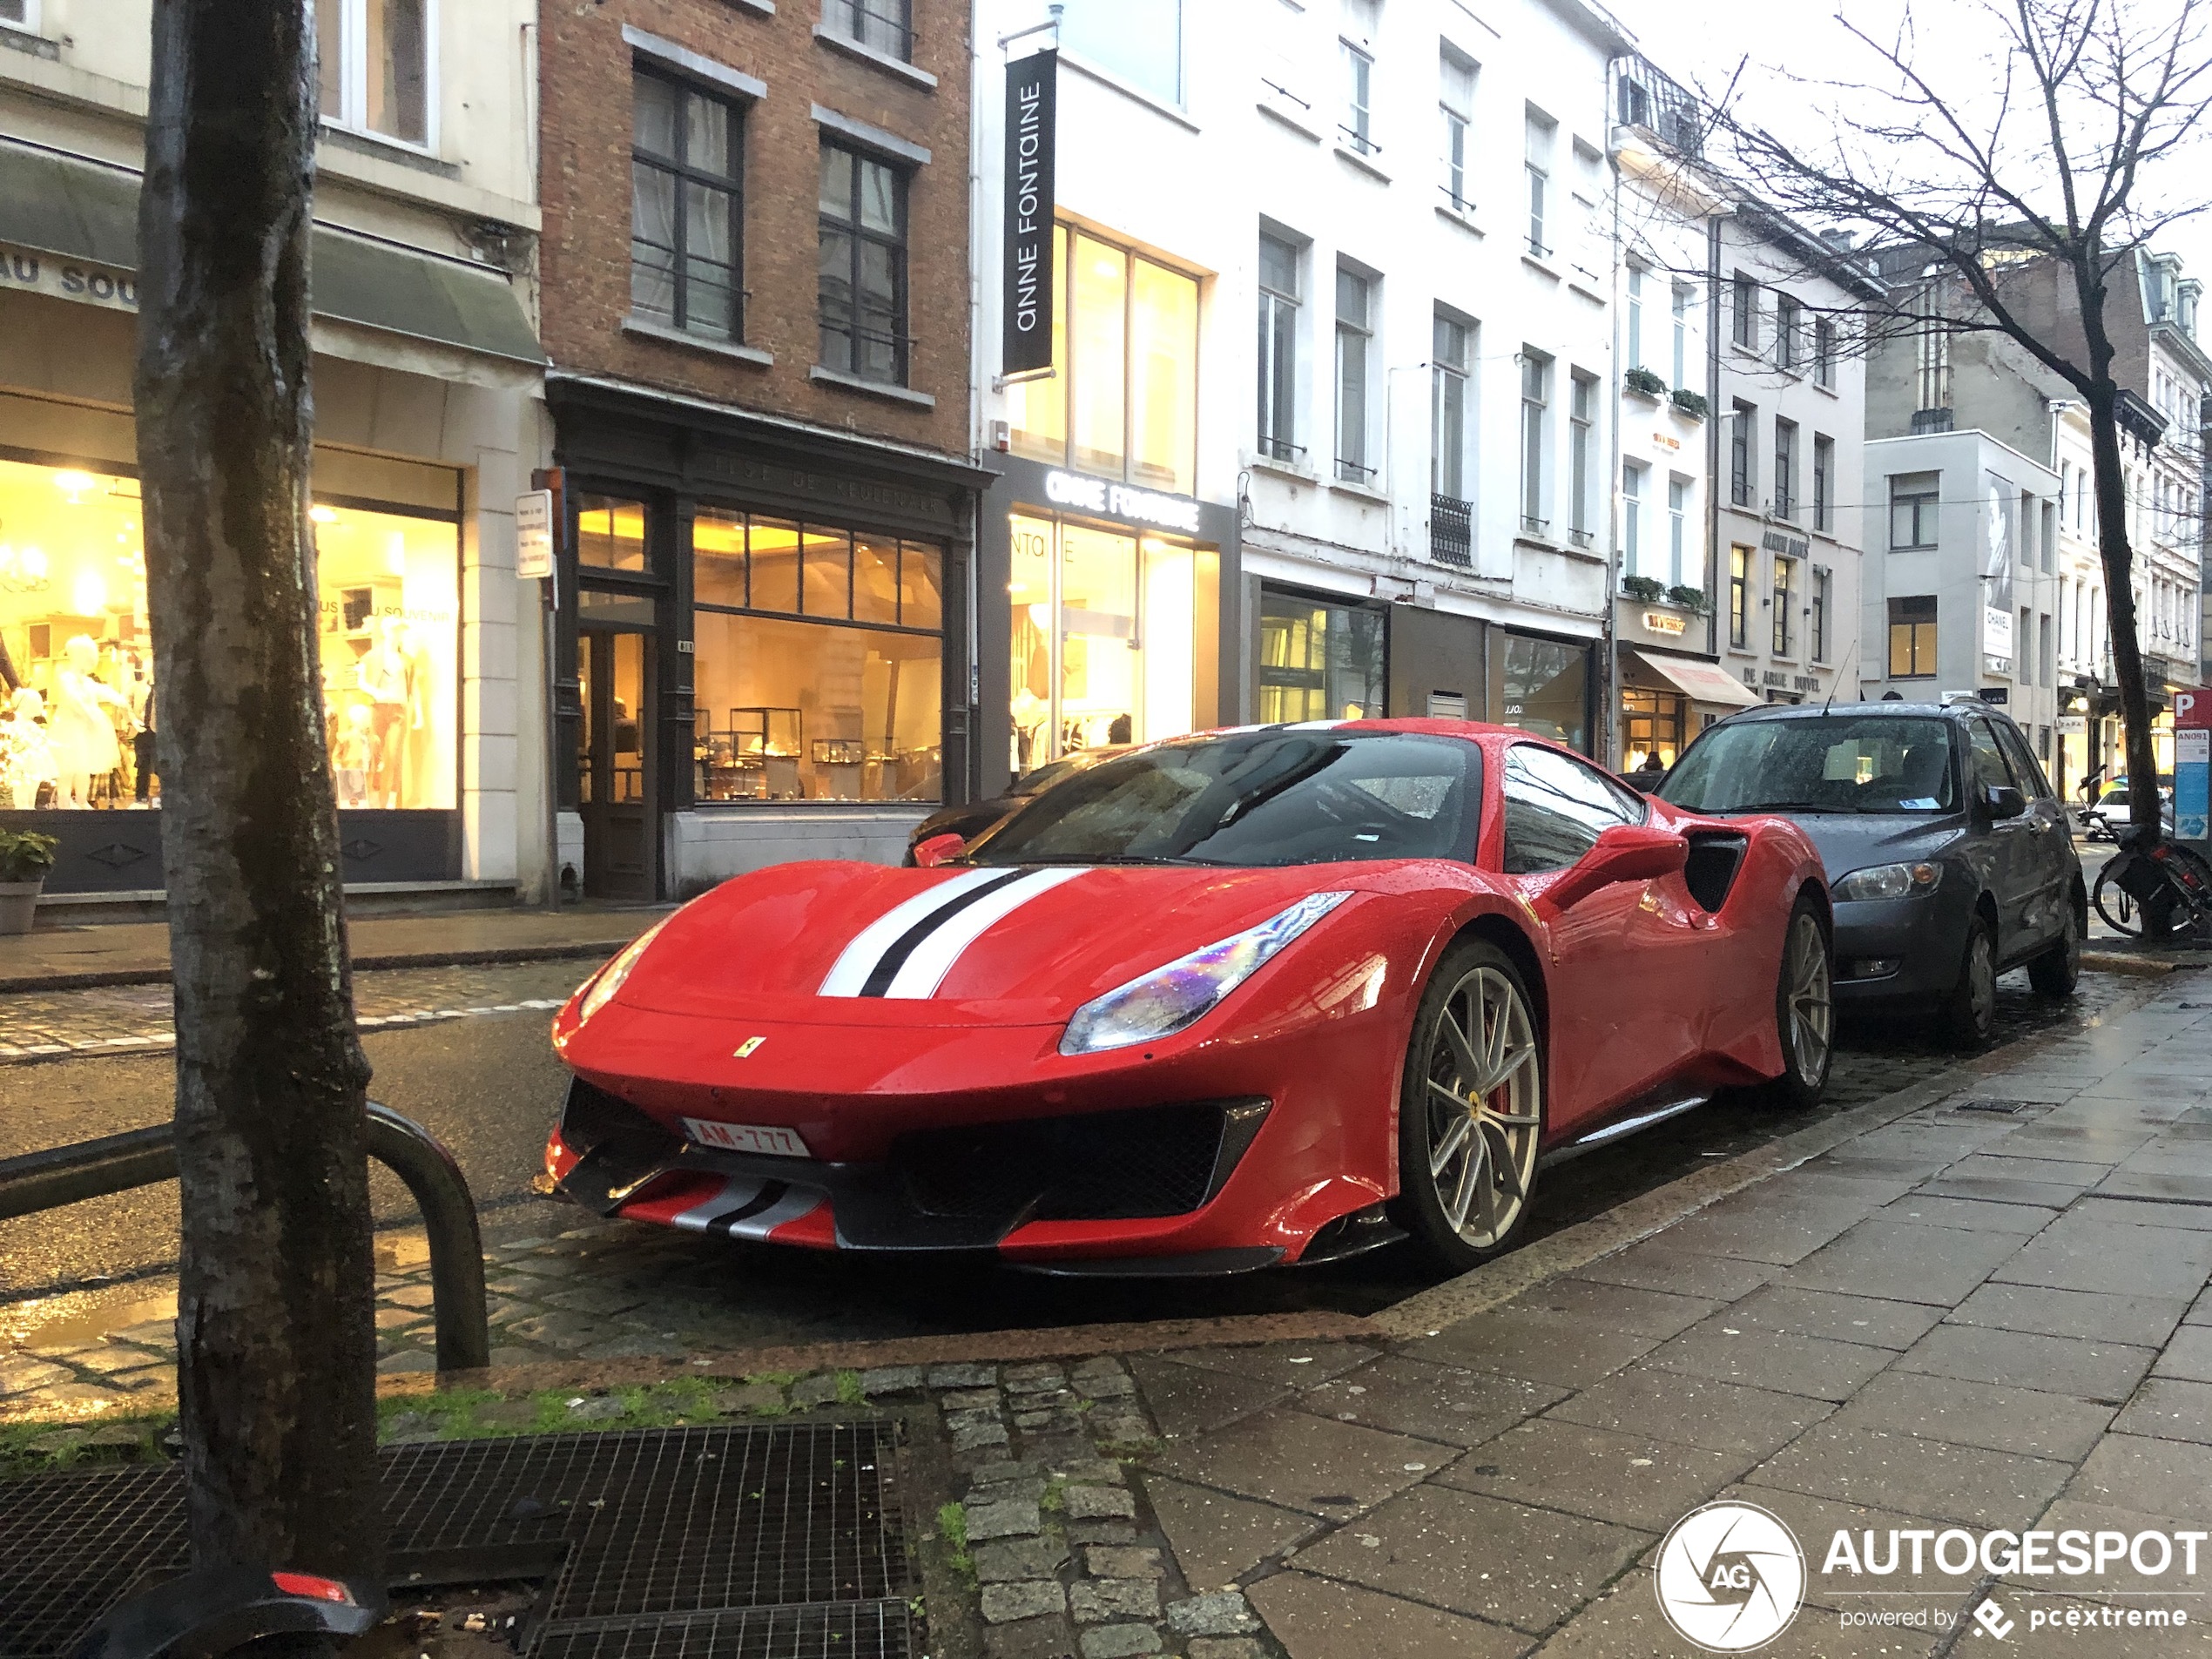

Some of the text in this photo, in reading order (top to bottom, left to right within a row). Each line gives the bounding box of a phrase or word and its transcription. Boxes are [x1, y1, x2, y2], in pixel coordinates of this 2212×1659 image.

[2176, 694, 2195, 718] P
[2178, 732, 2208, 741] AN091
[698, 1123, 793, 1152] AM-777
